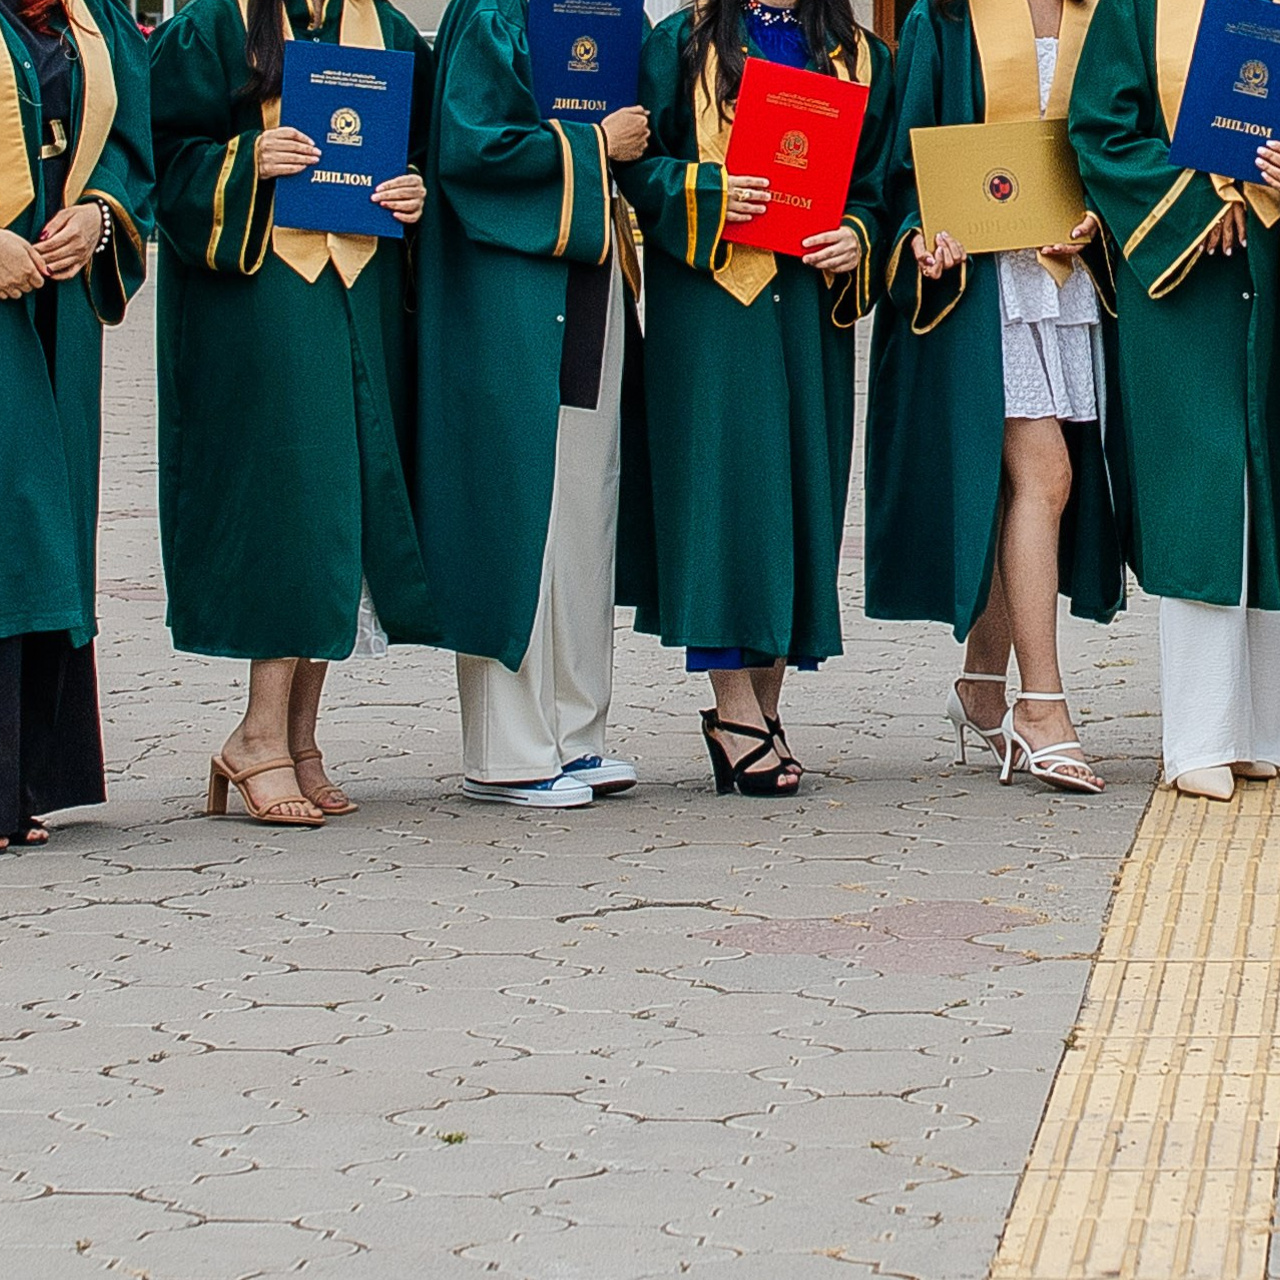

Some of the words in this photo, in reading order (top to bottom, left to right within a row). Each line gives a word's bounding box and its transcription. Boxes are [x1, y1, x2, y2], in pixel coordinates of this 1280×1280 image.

[552, 97, 607, 111] ДИПЛОМ
[1211, 115, 1273, 139] ДИПЛОМ
[311, 169, 372, 187] ДИПЛОМ
